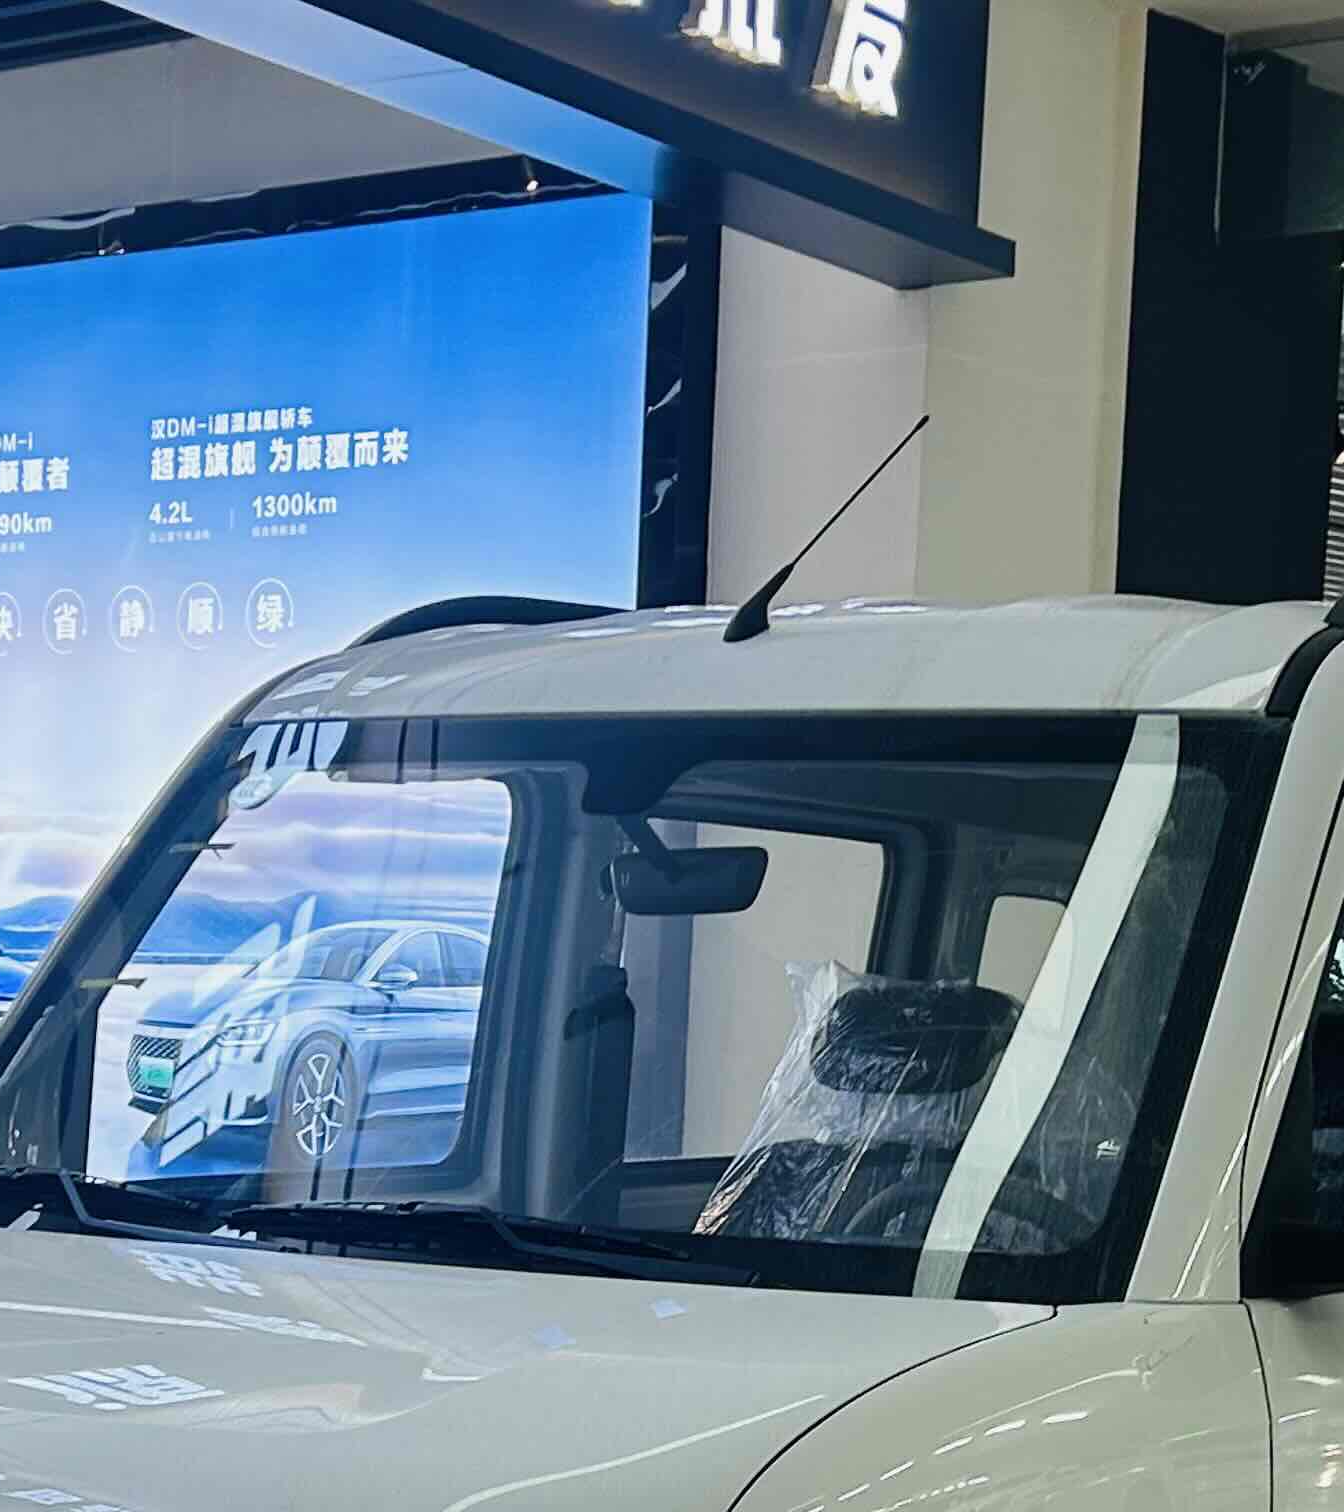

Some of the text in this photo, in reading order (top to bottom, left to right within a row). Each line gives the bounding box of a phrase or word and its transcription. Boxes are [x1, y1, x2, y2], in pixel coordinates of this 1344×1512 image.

[150, 428, 409, 481] 超混旗舰 为颠覆而来
[149, 491, 337, 524] 4.2L 1300km
[53, 602, 79, 640] 省
[256, 593, 285, 633] 绿
